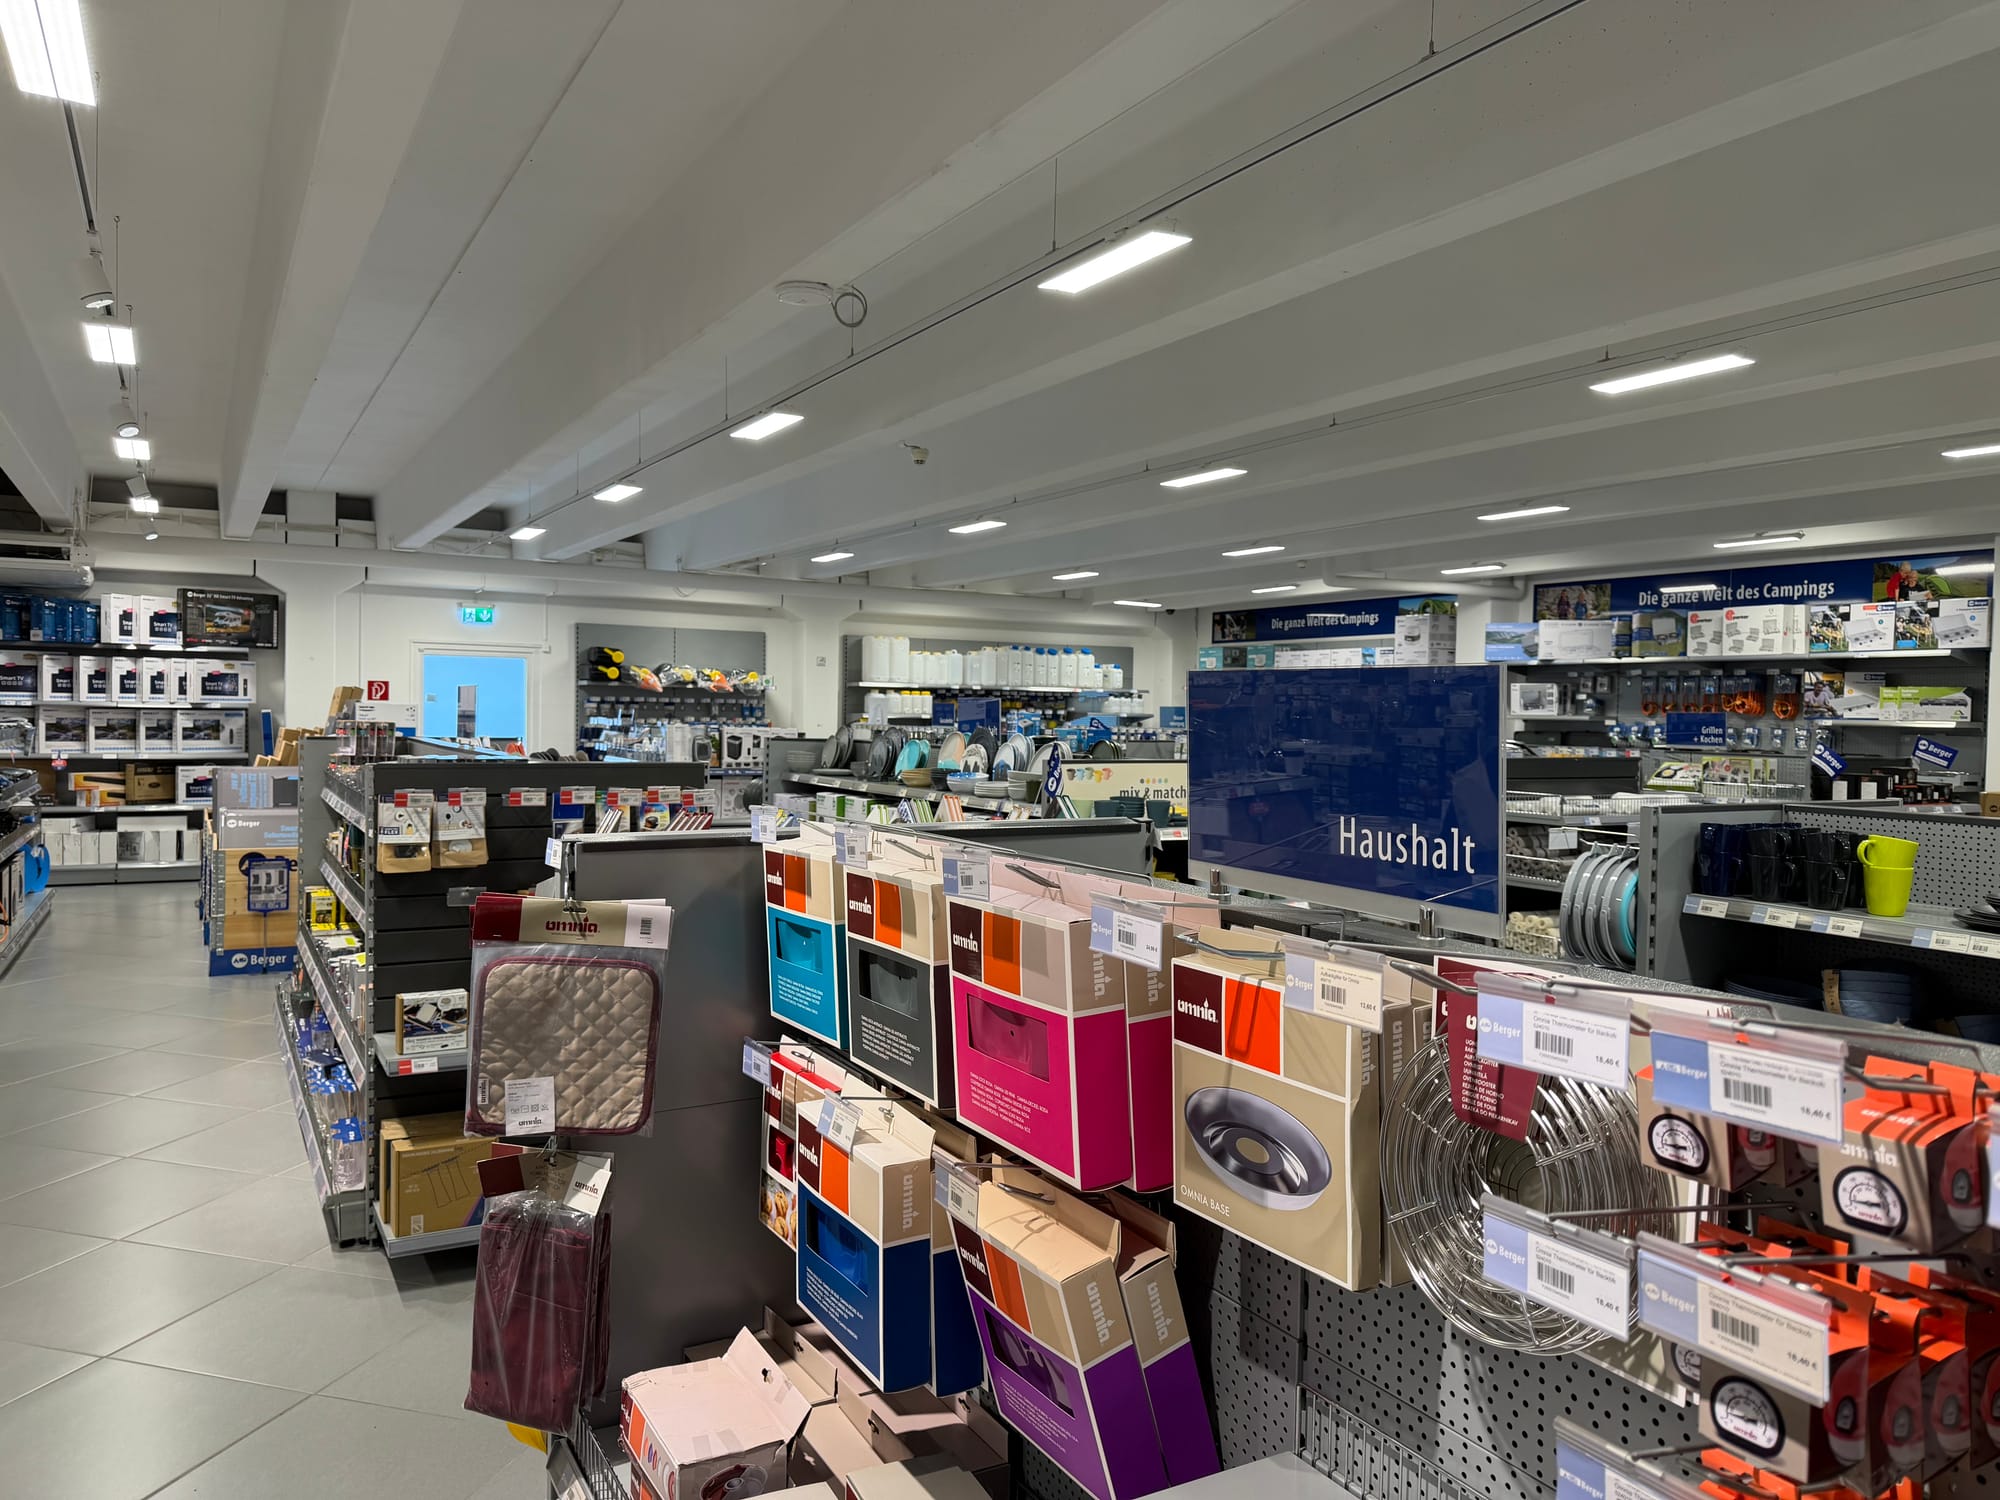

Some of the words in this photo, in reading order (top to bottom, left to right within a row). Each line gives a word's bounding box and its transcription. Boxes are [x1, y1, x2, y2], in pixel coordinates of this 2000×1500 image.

[1639, 591, 1658, 606] Die
[1661, 590, 1699, 608] ganze
[1702, 585, 1733, 602] Welt
[1736, 584, 1760, 600] des
[1763, 579, 1835, 600] Campings
[1271, 617, 1282, 630] Die
[1283, 617, 1306, 631] ganze
[1306, 614, 1324, 627] Welt
[1325, 613, 1339, 626] des
[1340, 611, 1379, 627] Campings
[1701, 725, 1723, 735] Grillen
[1700, 735, 1723, 744] Kochen
[1928, 744, 1953, 758] Berger
[1822, 751, 1843, 770] Berger
[1119, 786, 1140, 797] mix
[1143, 787, 1151, 799] &
[1153, 785, 1187, 799] match
[238, 820, 260, 828] Berger
[1339, 815, 1476, 874] Haushalt
[849, 896, 872, 915] omnia
[545, 915, 599, 934] omnia
[952, 930, 979, 953] omnia
[250, 954, 287, 966] Berger
[1295, 977, 1313, 991] Berger
[1177, 997, 1217, 1023] omnia
[1492, 1021, 1521, 1039] Berger
[1681, 1065, 1708, 1080] Berger
[1478, 1087, 1486, 1095] DE
[518, 1117, 542, 1127] omnia
[574, 1181, 599, 1195] omnia
[1180, 1184, 1209, 1208] OMNIA
[1210, 1198, 1230, 1217] BASE
[959, 1245, 987, 1276] omnia
[1498, 1245, 1526, 1265] Berger
[1661, 1288, 1697, 1314] Berger
